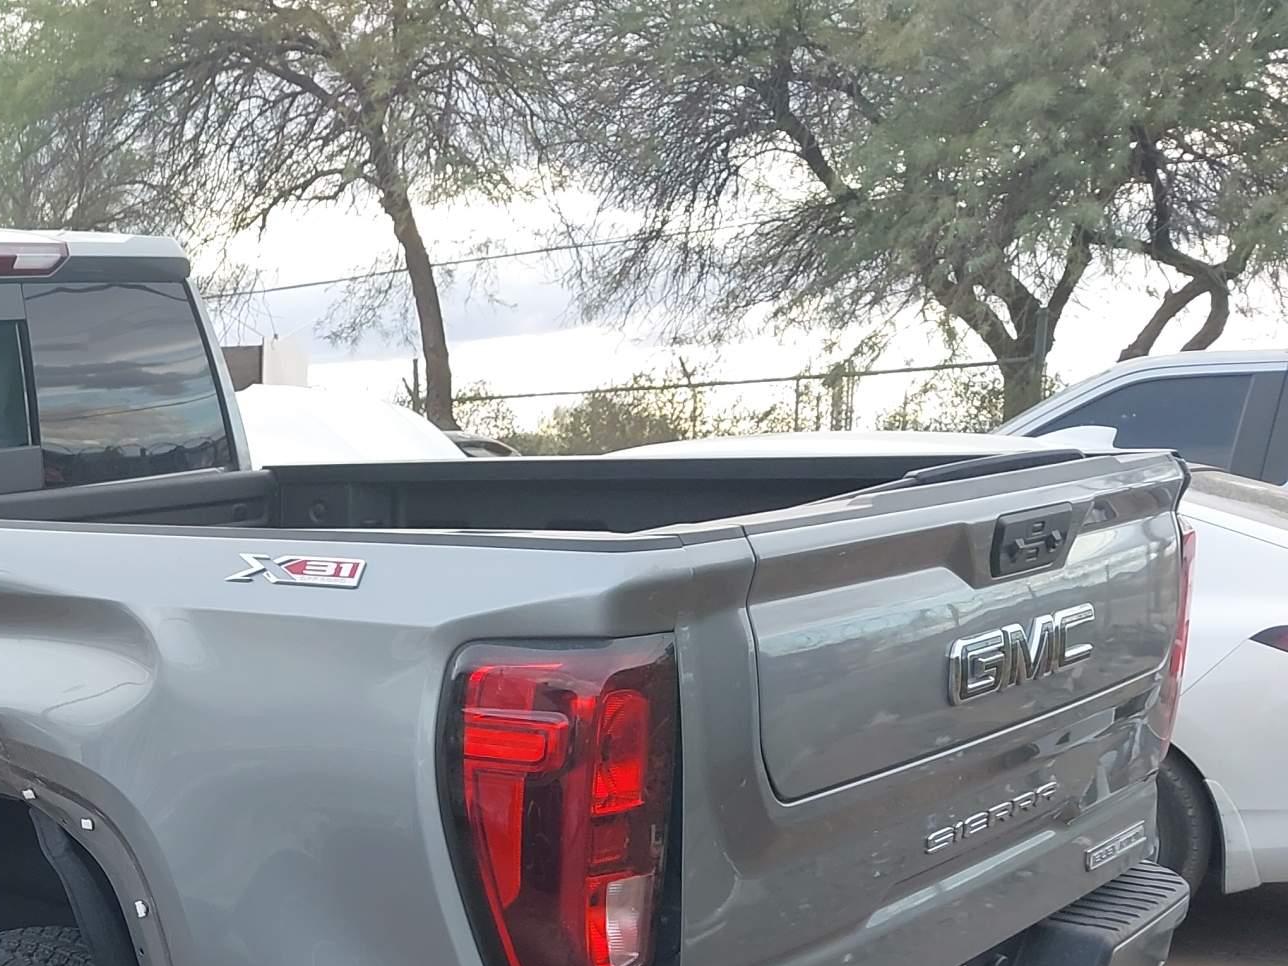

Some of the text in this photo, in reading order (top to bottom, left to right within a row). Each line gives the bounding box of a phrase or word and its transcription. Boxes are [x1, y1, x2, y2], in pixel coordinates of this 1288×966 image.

[224, 553, 364, 587] X31
[946, 602, 1095, 706] GMC
[925, 781, 1058, 853] SIERRA
